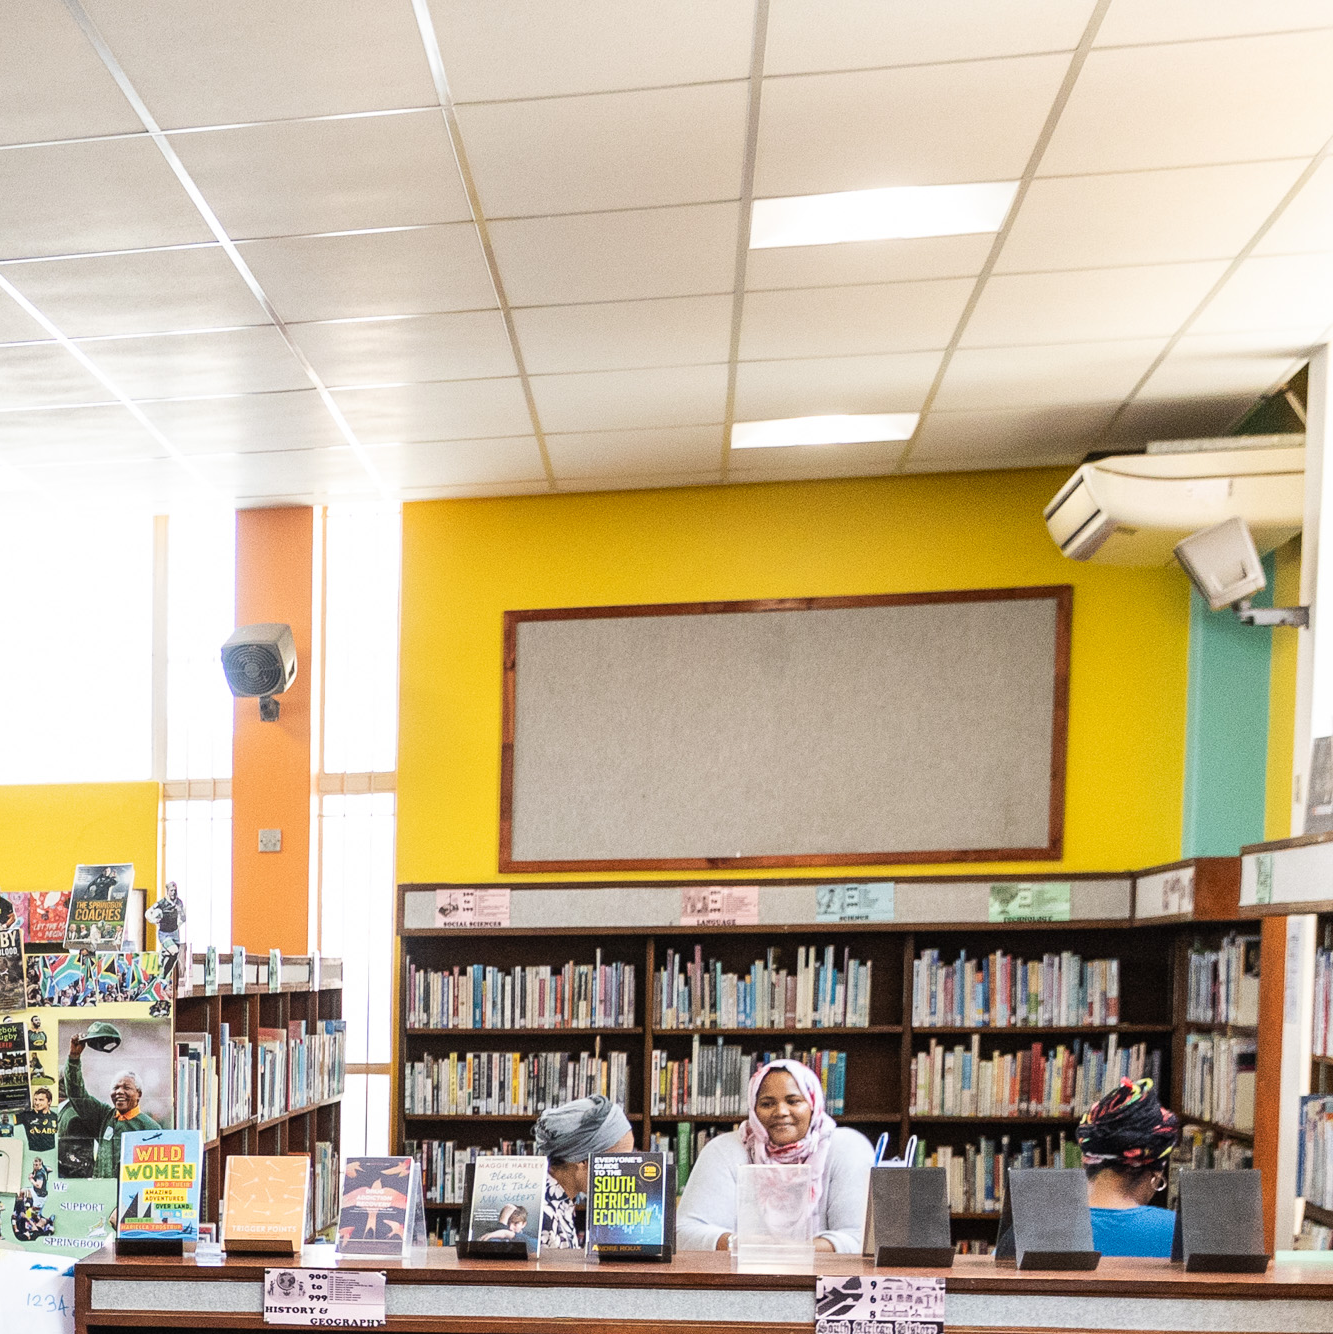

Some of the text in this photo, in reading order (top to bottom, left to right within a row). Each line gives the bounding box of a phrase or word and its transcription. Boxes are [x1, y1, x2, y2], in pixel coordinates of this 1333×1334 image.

[76, 901, 124, 910] THE SPRINGBOK
[75, 909, 121, 920] COACHES
[136, 1147, 182, 1161] WILD
[593, 1156, 644, 1164] EVERYONE'S
[477, 1162, 545, 1170] MAGGIE HARTLEY
[593, 1163, 620, 1171] GUIDE
[125, 1165, 193, 1180] WOMEN
[490, 1171, 525, 1181] Please,
[593, 1169, 622, 1177] TO THE
[52, 1181, 69, 1192] WE
[480, 1181, 540, 1192] Don't Take
[594, 1177, 635, 1192] SOUTH
[144, 1188, 174, 1196] AMAZING
[479, 1192, 536, 1205] My Sisters
[594, 1193, 647, 1209] AFRICAN
[59, 1202, 105, 1212] SUPPORT
[173, 1202, 193, 1210] LAND,
[594, 1210, 652, 1225] ECONOMY
[231, 1223, 298, 1235] TRIGGER POINTS
[308, 1273, 328, 1281] 900
[311, 1283, 323, 1291] to
[870, 1280, 878, 1290] 9
[308, 1294, 328, 1302] 999
[869, 1294, 877, 1304] 6
[264, 1306, 329, 1315] HISTORY &
[869, 1310, 876, 1319] 8
[309, 1317, 384, 1328] GEOGRAPHY
